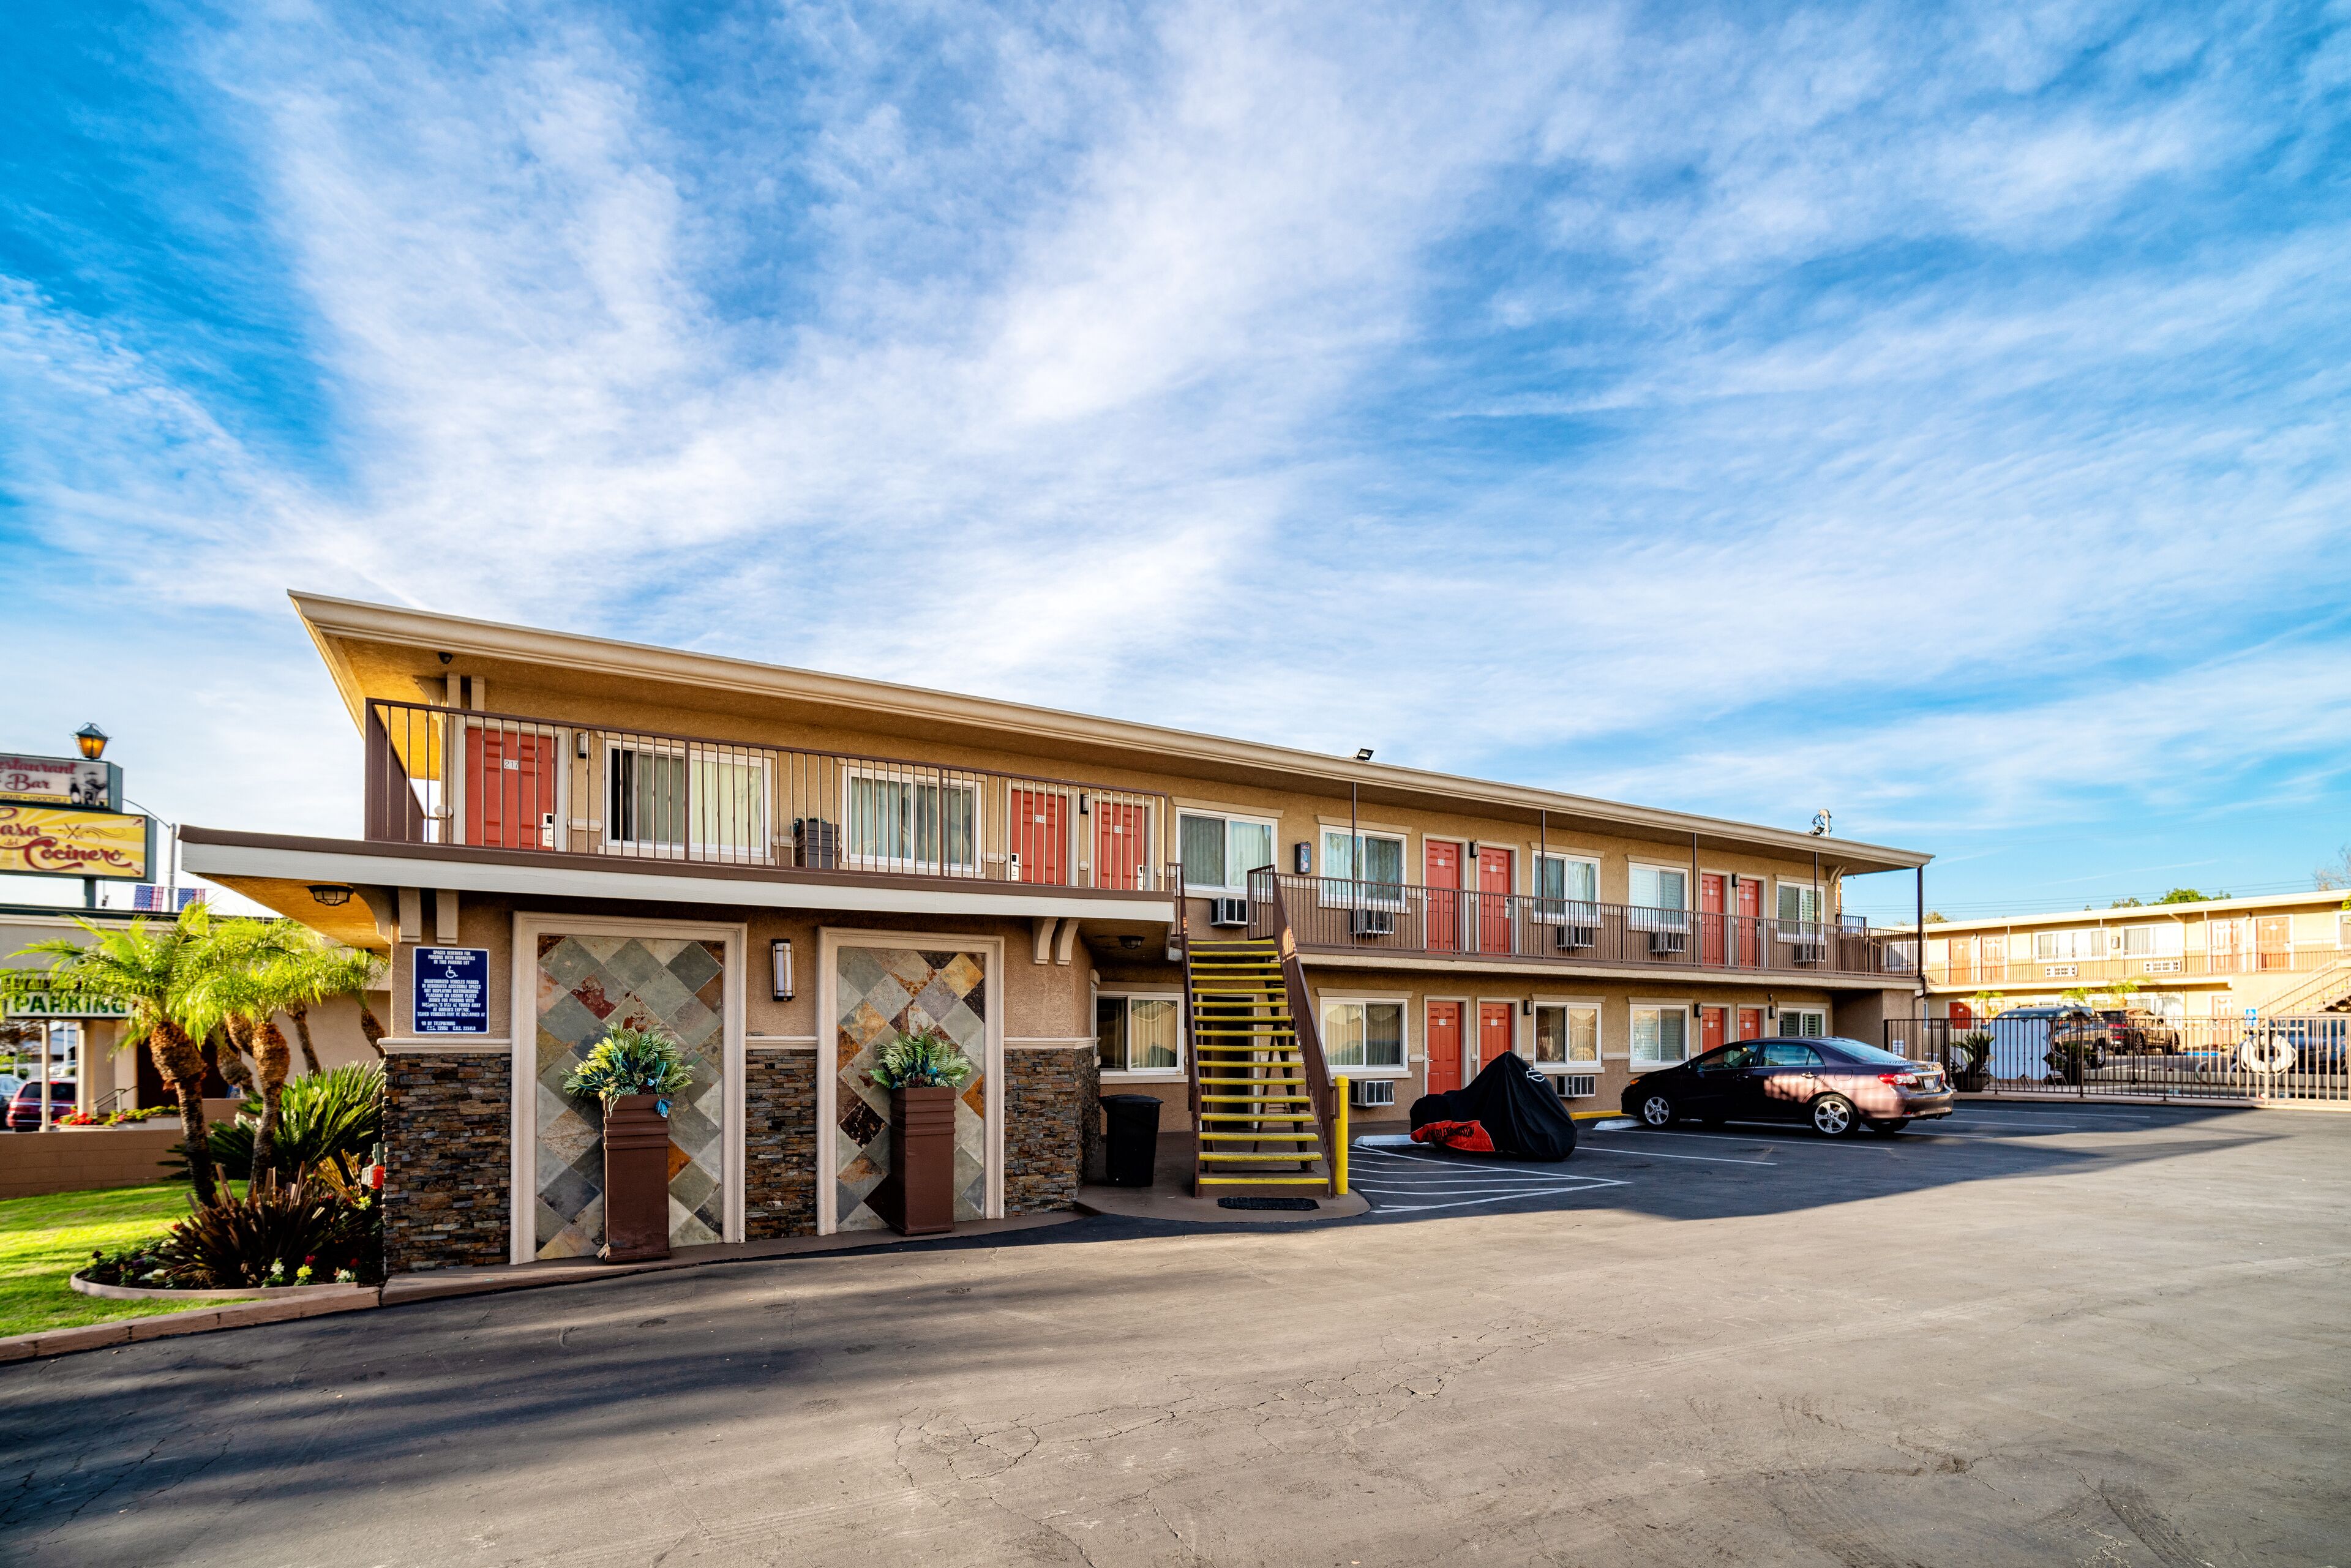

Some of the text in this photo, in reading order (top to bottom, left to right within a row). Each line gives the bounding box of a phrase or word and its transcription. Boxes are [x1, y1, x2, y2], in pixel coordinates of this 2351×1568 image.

[0, 757, 75, 774] estaurant
[5, 773, 50, 790] Bar
[24, 836, 132, 871] Cocinero
[13, 996, 126, 1013] PARKING
